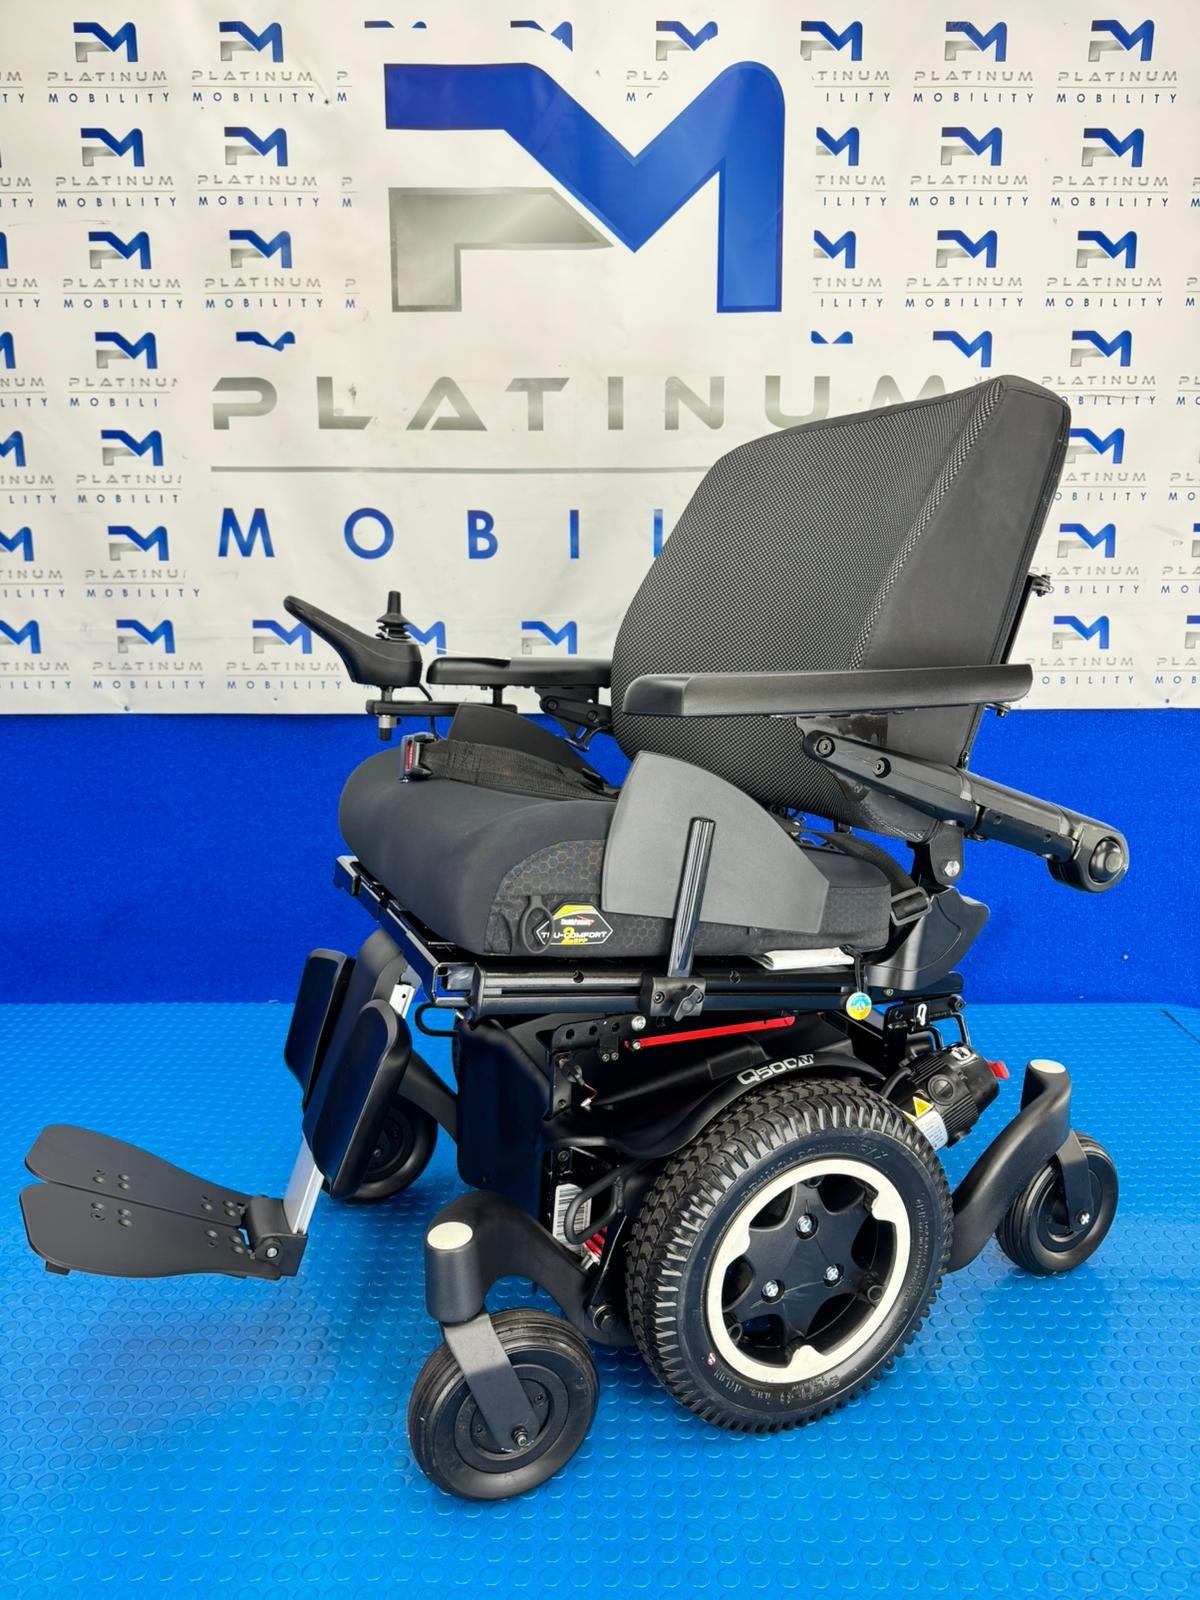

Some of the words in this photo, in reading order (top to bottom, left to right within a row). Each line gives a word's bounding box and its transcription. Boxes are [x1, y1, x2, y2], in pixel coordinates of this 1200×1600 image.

[48, 71, 167, 82] PLATINUM
[192, 70, 312, 81] PLATINUM
[811, 71, 890, 81] TINUM
[914, 70, 1033, 81] PLATINUM
[1058, 71, 1177, 82] PLATINUM
[48, 92, 169, 104] MOBILITY
[193, 90, 314, 103] MOBILITY
[913, 92, 1033, 103] MOBILITY
[1056, 93, 1176, 104] MOBILITY
[56, 176, 173, 186] PLATINUM
[197, 175, 317, 186] PLATINUM
[911, 175, 1028, 185] PLATINUM
[1052, 176, 1168, 186] PLATINUM
[384, 61, 786, 313] PM
[57, 197, 176, 208] MOBILITY
[198, 196, 319, 207] MOBILITY
[909, 195, 1028, 206] MOBILITY
[1051, 197, 1168, 208] MOBILITY
[63, 278, 181, 288] PLATINUM
[205, 277, 321, 287] PLATINUM
[907, 277, 1022, 287] PLATINUM
[1047, 277, 1162, 287] PLATINUM
[64, 299, 183, 309] MOBILITY
[205, 298, 323, 308] MOBILITY
[905, 297, 1023, 308] MOBILITY
[1045, 297, 1163, 307] MOBILITY
[1041, 376, 1155, 385] PLATINUM
[76, 474, 181, 484] PLATINU
[0, 570, 62, 579] INUM
[85, 569, 186, 579] PLATINU
[402, 621, 446, 654] M
[93, 662, 202, 670] PLATINUM
[226, 662, 340, 671] PLATINUM
[93, 680, 205, 689] MOBILITY
[227, 681, 341, 689] MOBILITY
